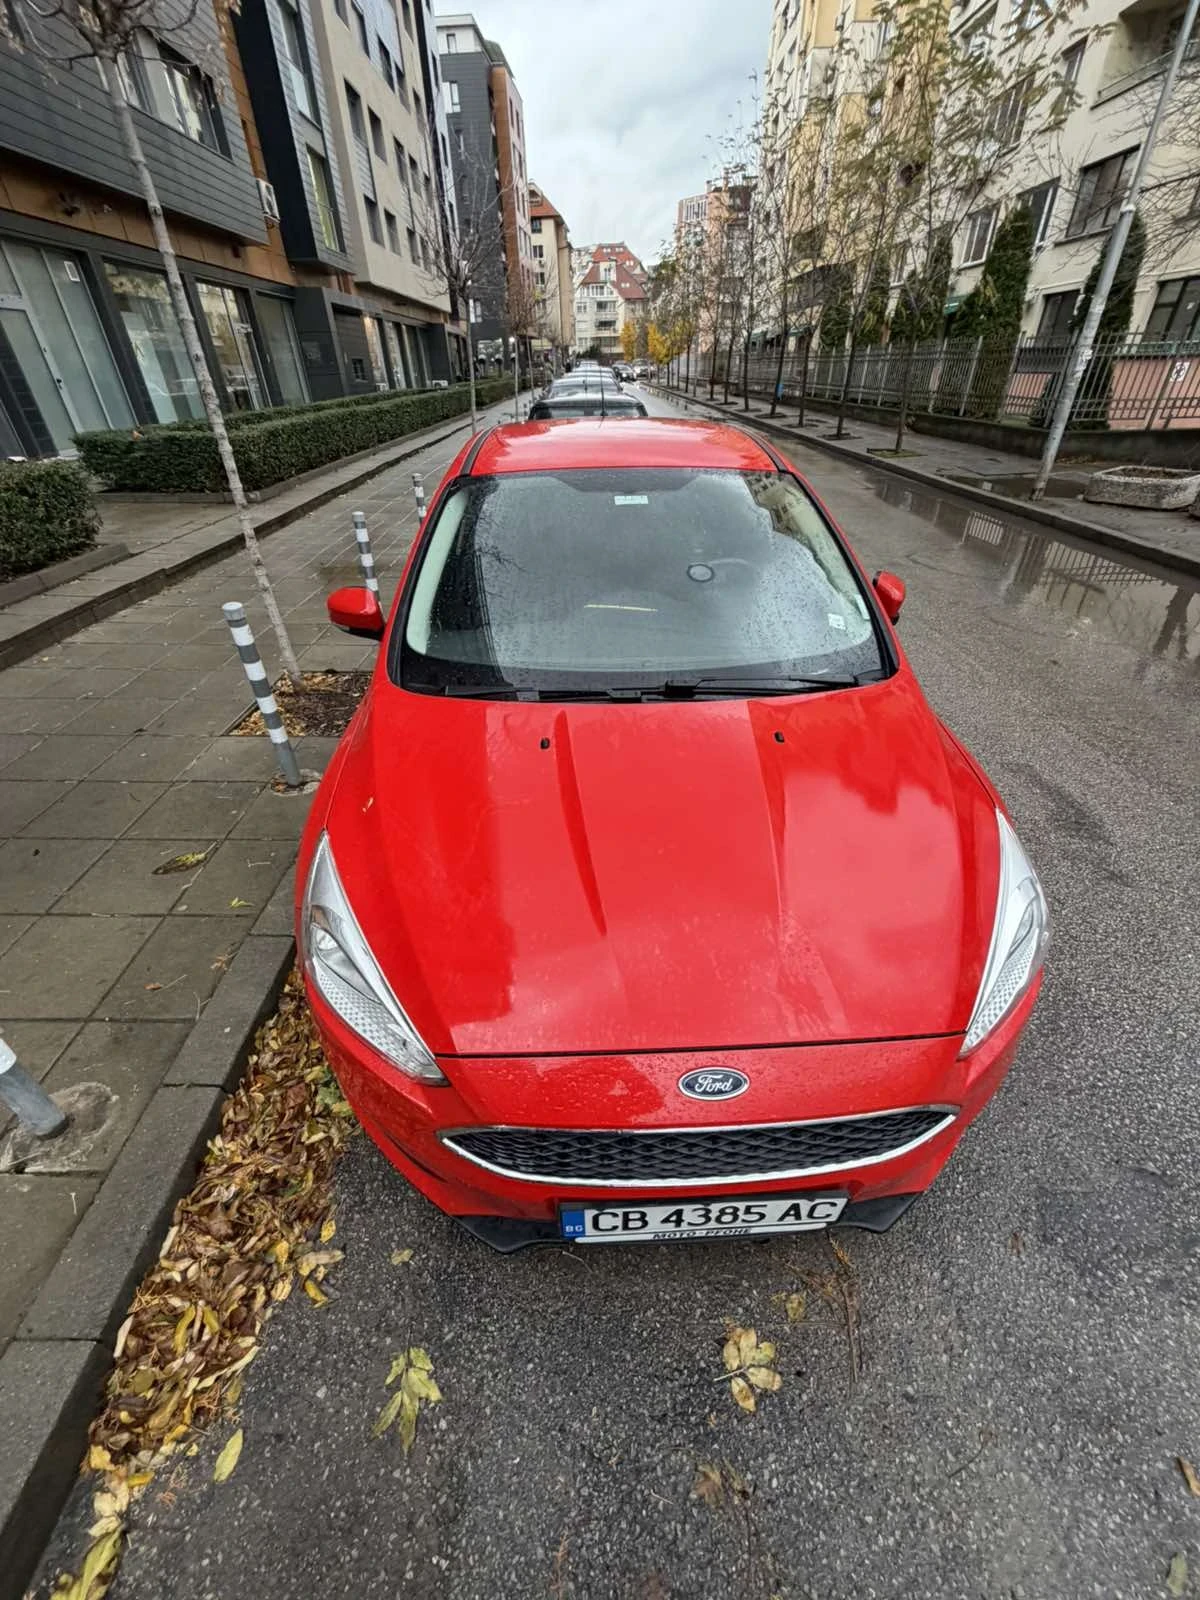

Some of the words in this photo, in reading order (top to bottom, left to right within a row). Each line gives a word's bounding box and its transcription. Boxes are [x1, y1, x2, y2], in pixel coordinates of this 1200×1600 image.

[694, 1074, 734, 1093] Ford
[565, 1225, 583, 1233] BG
[592, 1211, 649, 1232] CB
[660, 1204, 768, 1228] 4385
[777, 1201, 838, 1222] AC
